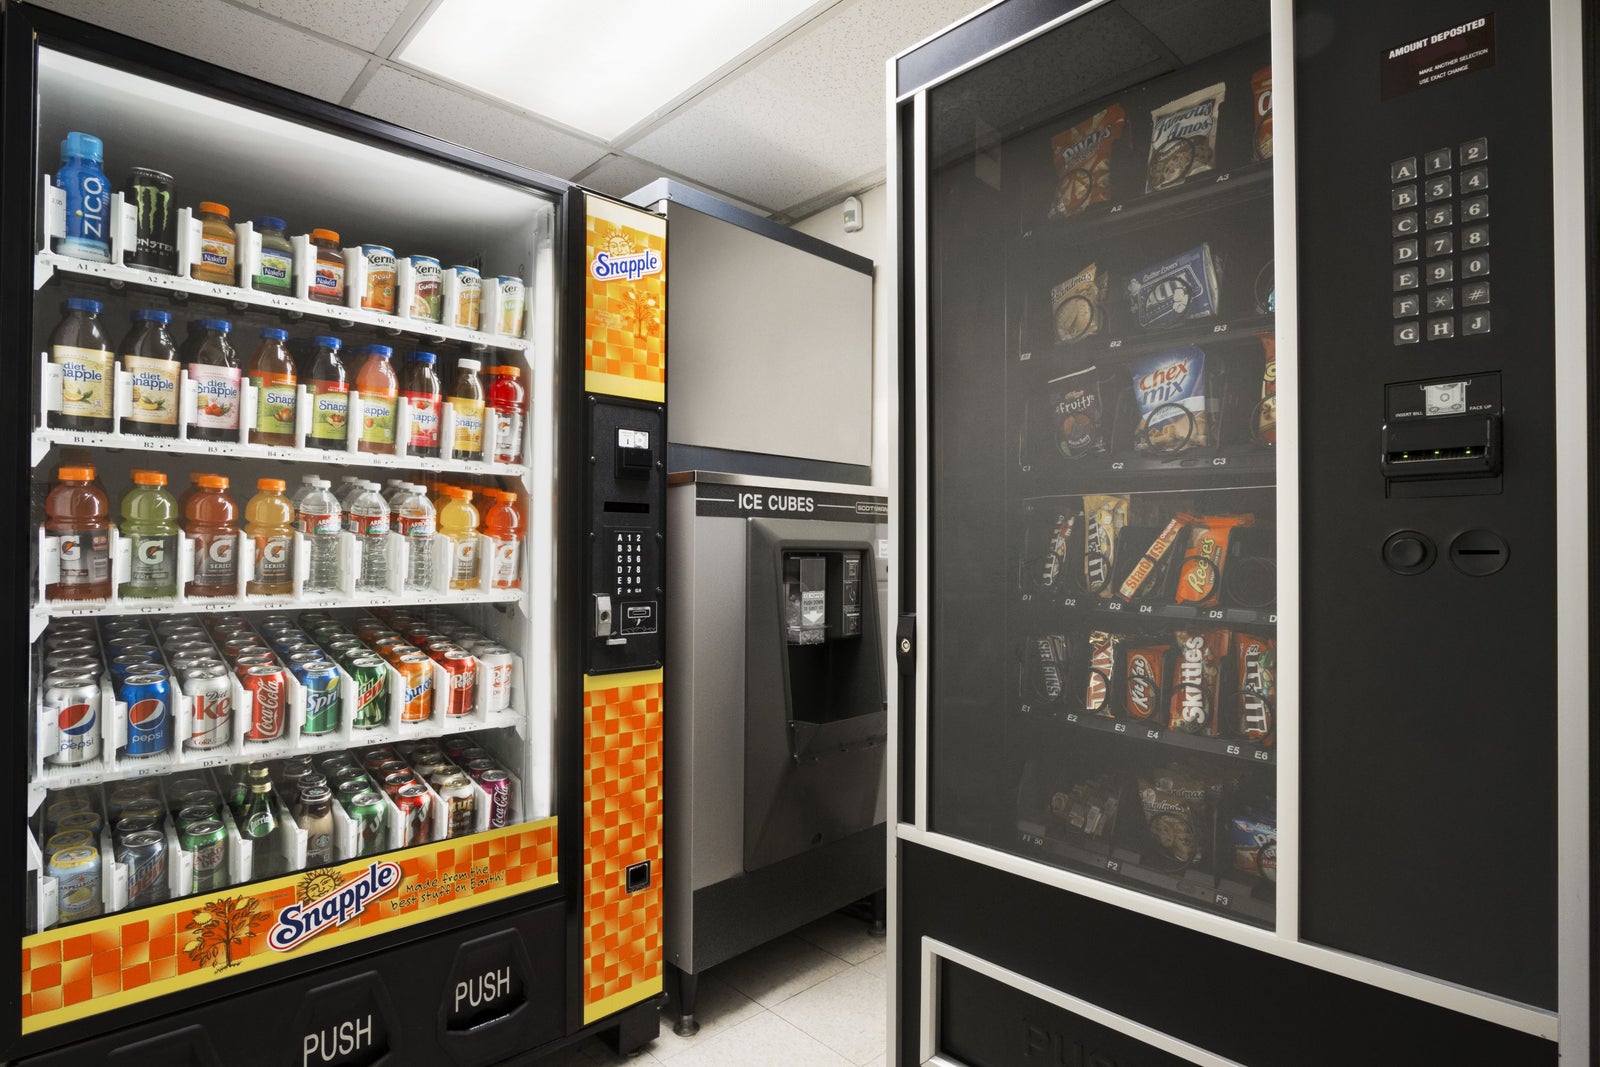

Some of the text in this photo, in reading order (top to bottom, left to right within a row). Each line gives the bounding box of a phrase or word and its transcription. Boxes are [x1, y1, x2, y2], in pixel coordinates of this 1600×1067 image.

[1388, 18, 1486, 60] AMOUNT DEPOSITED
[1418, 48, 1489, 76] MAKE ANOTHER SELECTION
[1418, 64, 1470, 86] USE EXACT CHANGE
[1397, 147, 1479, 179] A 1 2
[1216, 173, 1230, 183] A3
[1398, 175, 1480, 205] B 3 4
[84, 177, 105, 239] ZICO
[1110, 204, 1123, 213] A2
[1398, 203, 1480, 232] C 5 6
[1399, 232, 1480, 259] D 7 8
[204, 254, 226, 264] Naked
[596, 251, 658, 279] Snapple
[264, 267, 285, 277] Naked
[1399, 260, 1481, 286] E 9 0
[147, 275, 158, 283] A2
[316, 276, 336, 287] Naked
[1400, 289, 1484, 314] F #
[1400, 317, 1482, 340] G H J
[64, 362, 86, 371] diet
[63, 368, 102, 383] napple
[140, 372, 161, 381] diet
[207, 379, 227, 388] diet
[1143, 374, 1187, 405] mix
[1112, 462, 1124, 470] C2
[1213, 457, 1226, 466] C3
[738, 493, 814, 513] ICE CUBES
[617, 533, 641, 542] A 1 2
[138, 539, 165, 566] G
[209, 539, 232, 563] G
[263, 540, 286, 563] G
[617, 544, 641, 553] B 3 4
[617, 555, 641, 563] C 5 6
[1125, 538, 1167, 590] Starbrst
[617, 565, 641, 574] D 7 8
[617, 576, 641, 585] E 9 0
[617, 587, 624, 596] F
[1064, 598, 1076, 606] D2
[1109, 602, 1121, 610] D3
[1140, 605, 1152, 613] D4
[1209, 610, 1223, 619] D5
[192, 695, 231, 721] ke
[1067, 713, 1078, 722] E2
[1114, 723, 1126, 732] E3
[132, 730, 163, 744] pepsi
[1146, 729, 1159, 739] E4
[60, 737, 94, 752] pepsi
[1226, 745, 1240, 755] E5
[1254, 751, 1268, 761] E6
[491, 784, 510, 828] Coca-Cola
[1107, 860, 1119, 871] F2
[406, 864, 489, 895] Made from the
[390, 893, 417, 912] best
[421, 886, 452, 905] stuff
[455, 882, 469, 894] on
[1215, 895, 1228, 905] F3
[274, 863, 393, 944] Snapple
[455, 966, 510, 1013] PUSH
[303, 1013, 372, 1067] PUSH
